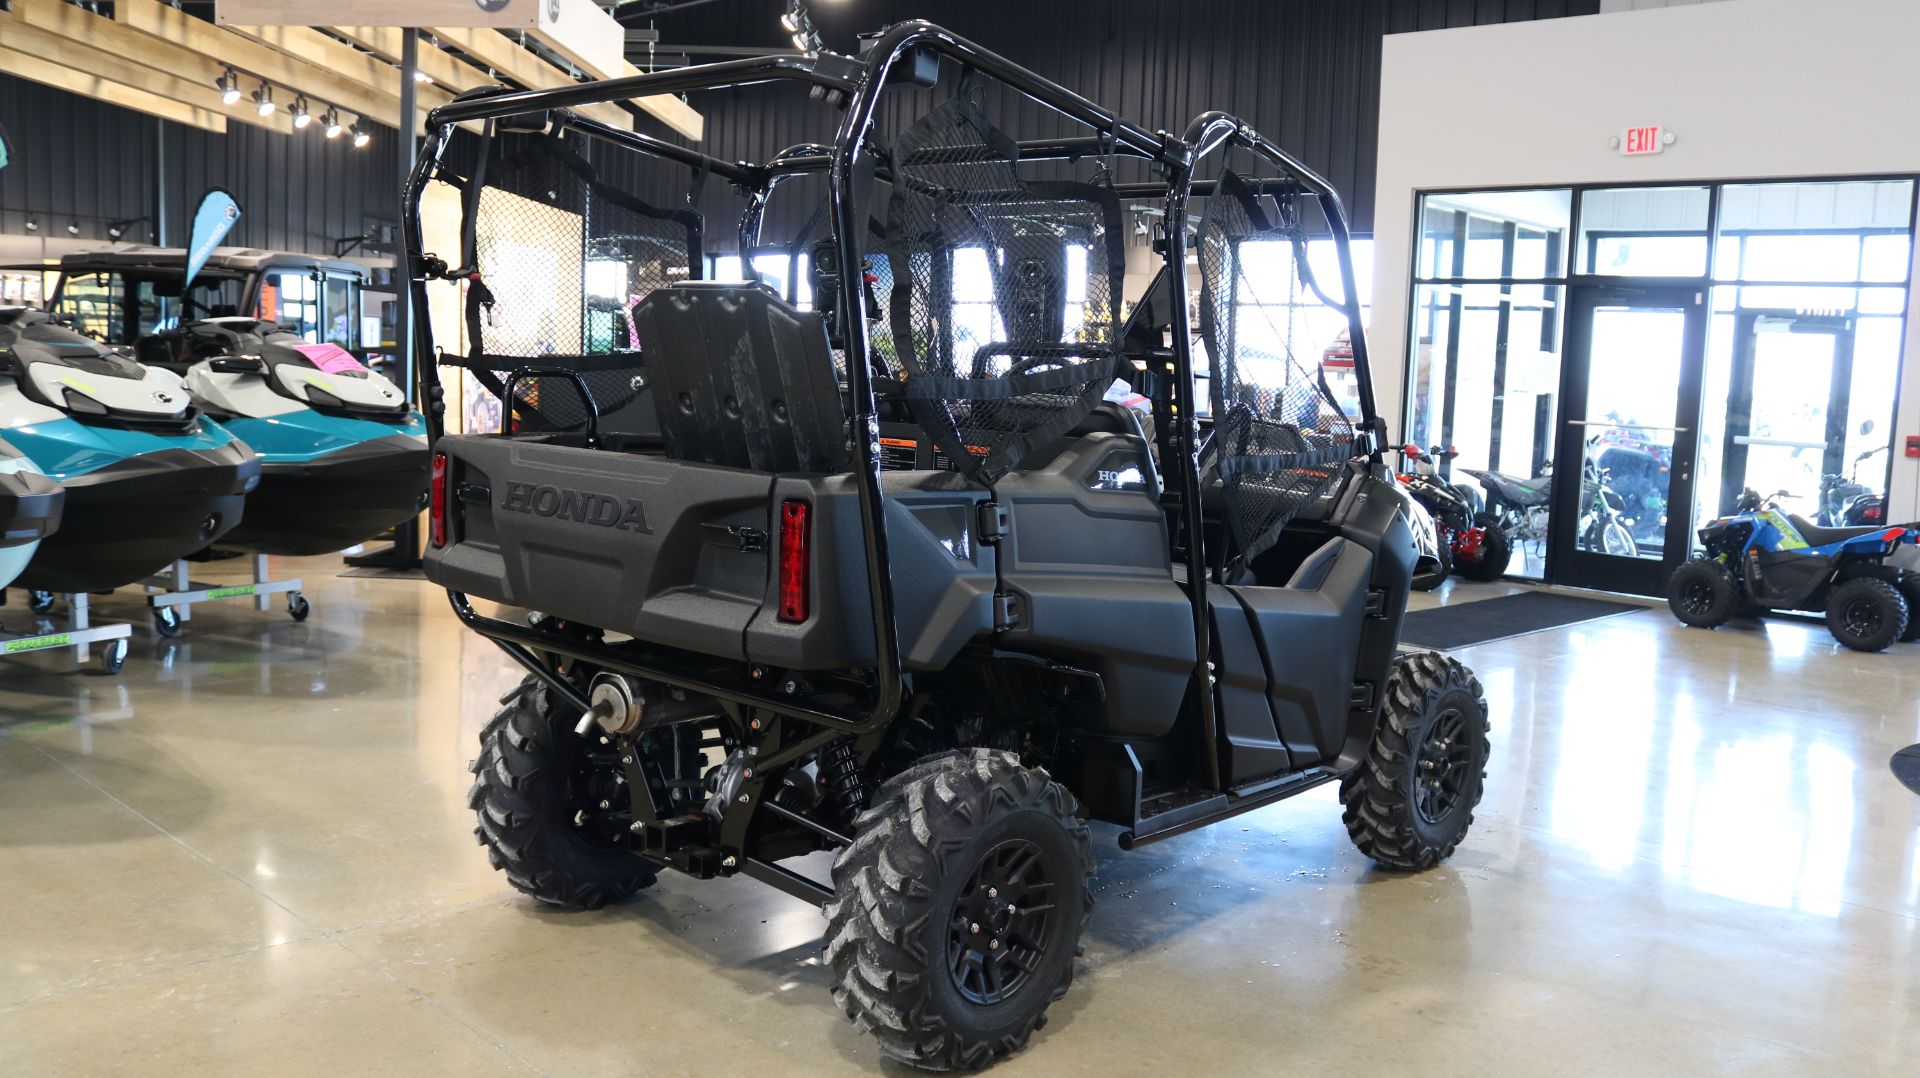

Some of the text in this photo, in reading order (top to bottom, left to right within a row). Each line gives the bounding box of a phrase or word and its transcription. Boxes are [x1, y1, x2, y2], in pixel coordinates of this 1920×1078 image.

[1627, 127, 1658, 152] EXIT
[1098, 470, 1147, 484] HOA
[501, 480, 653, 535] HONDA
